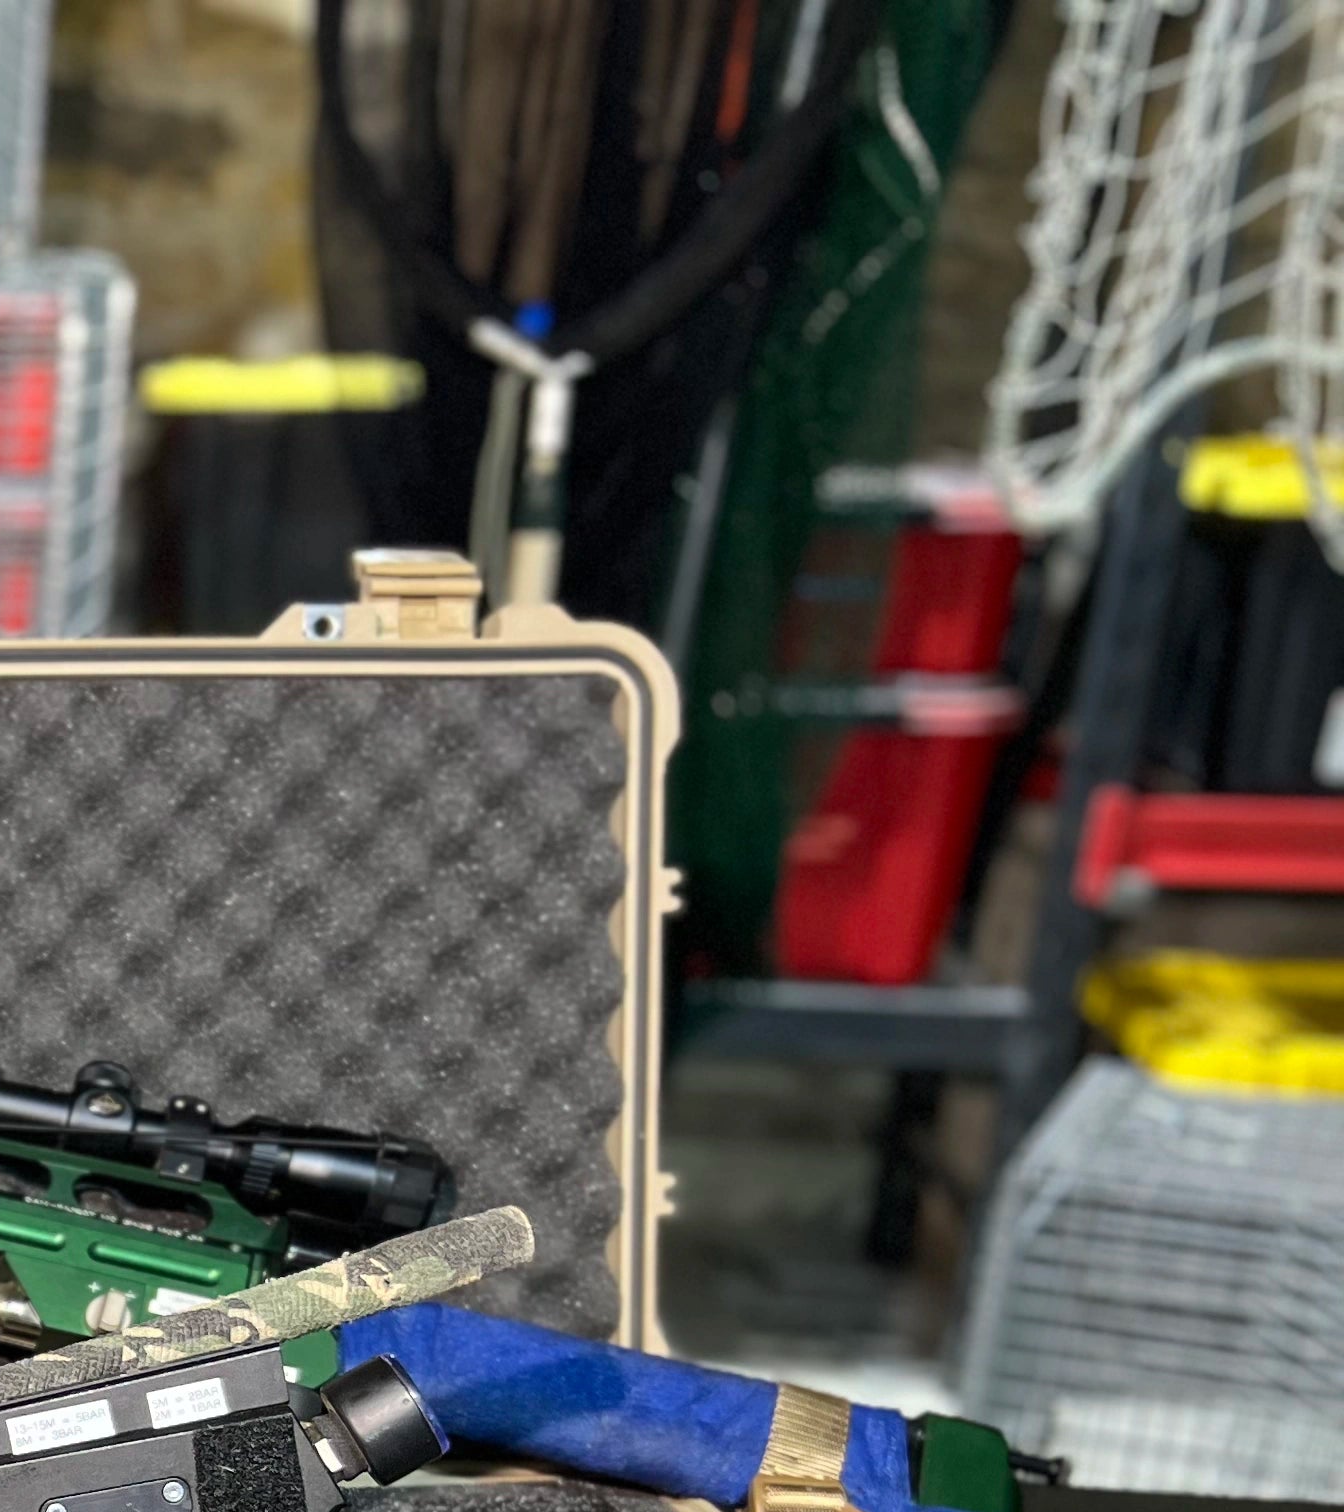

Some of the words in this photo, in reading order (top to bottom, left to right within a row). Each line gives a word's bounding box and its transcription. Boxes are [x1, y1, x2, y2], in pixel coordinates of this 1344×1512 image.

[188, 1386, 219, 1401] 2BAR
[192, 1398, 221, 1413] 1BAR
[14, 1418, 56, 1435] 13-15M
[75, 1408, 107, 1422] 5BAR
[52, 1425, 83, 1441] 3BAR
